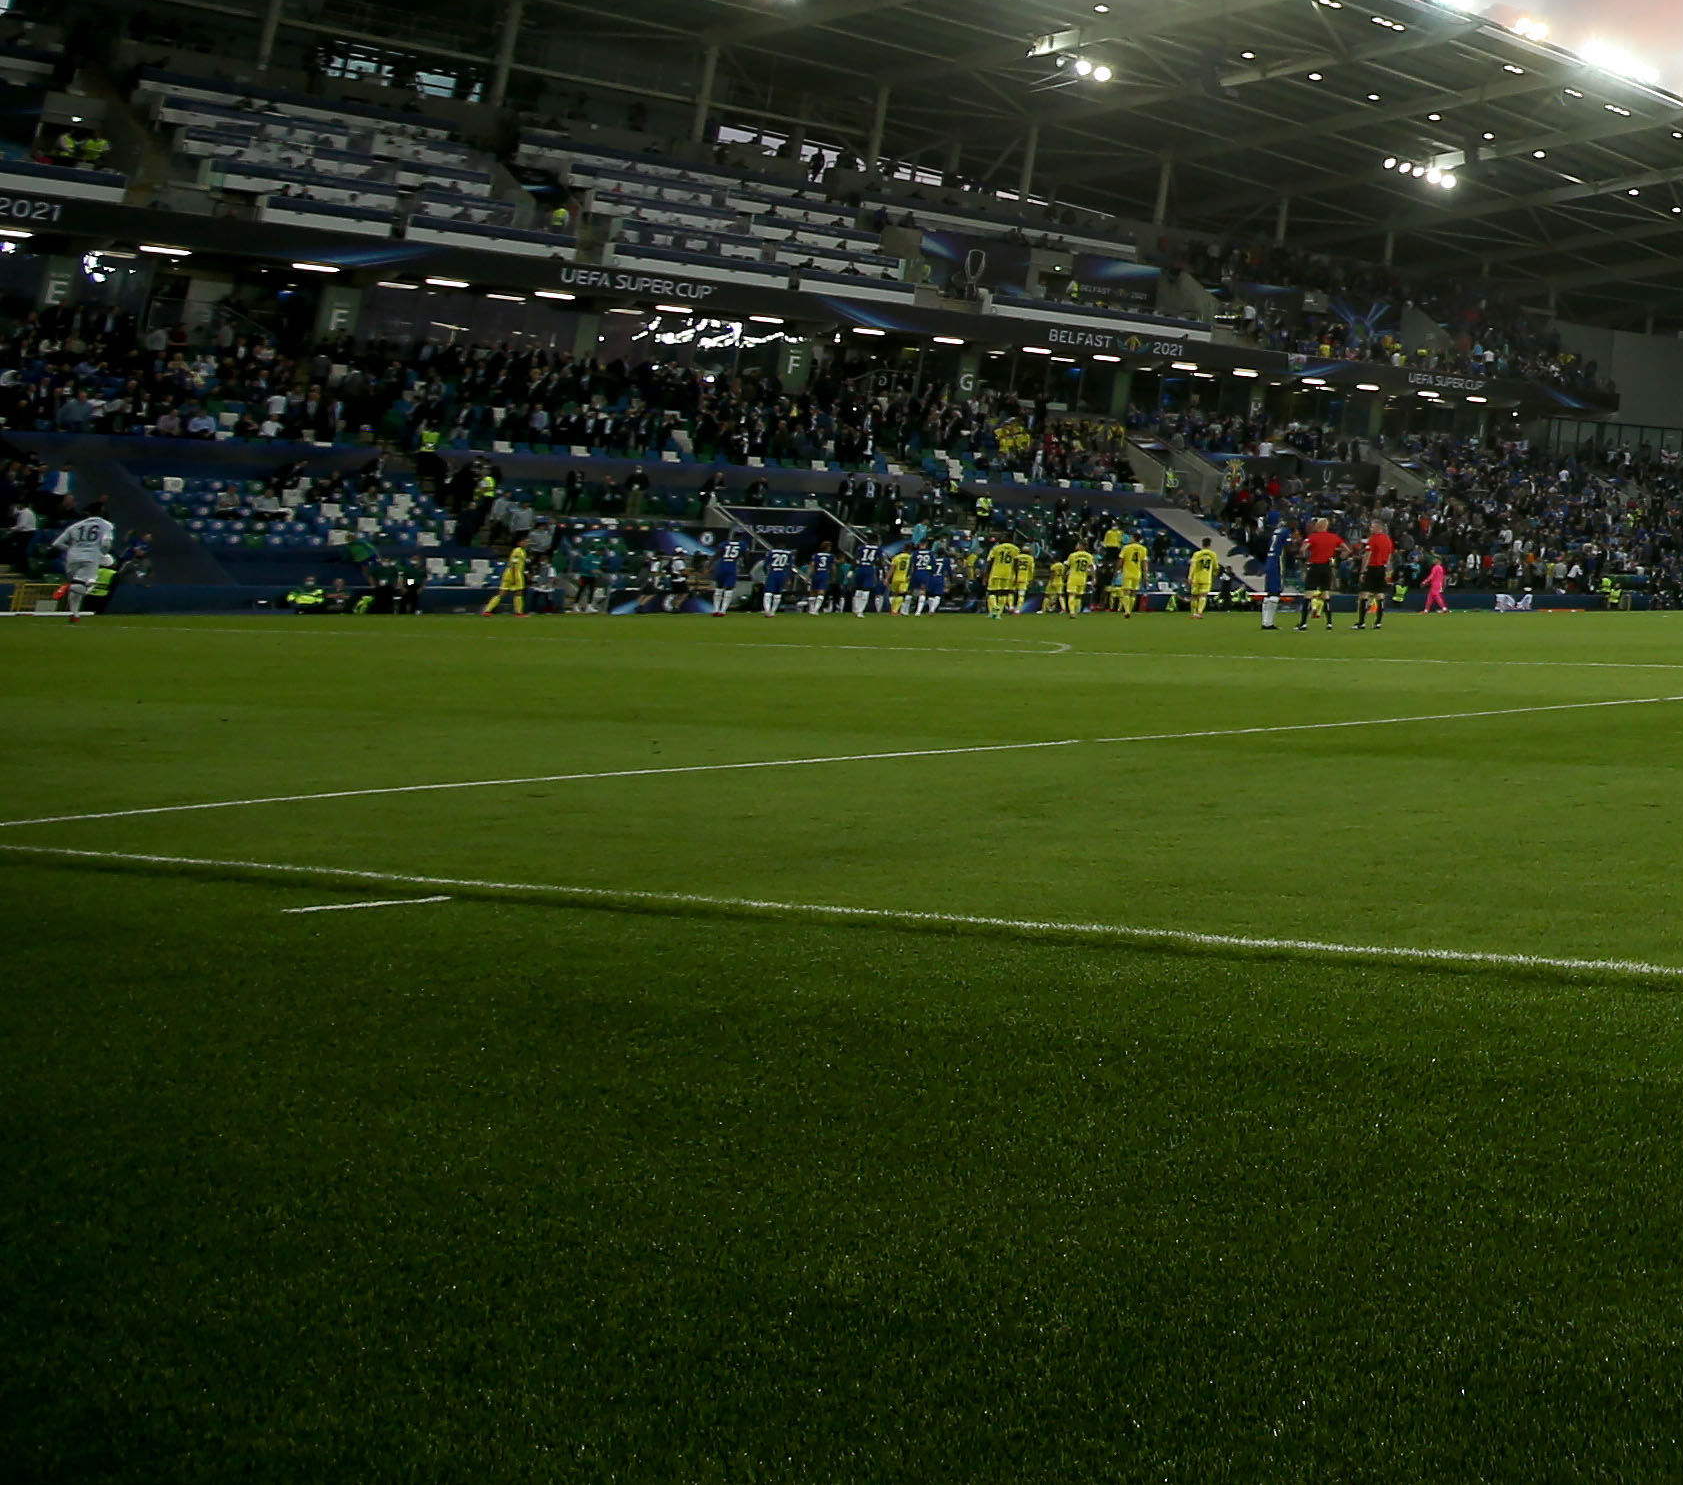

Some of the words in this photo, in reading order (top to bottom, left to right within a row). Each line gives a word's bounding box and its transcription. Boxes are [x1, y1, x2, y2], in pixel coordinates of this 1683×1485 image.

[0, 196, 62, 222] 2021
[560, 267, 611, 289] UEFA
[614, 274, 674, 296] SUPER
[675, 282, 713, 299] CUP
[1048, 328, 1113, 349] BELFAST
[1152, 341, 1184, 357] 2021
[959, 373, 975, 391] G
[77, 524, 100, 543] 16
[723, 545, 741, 559] 15
[771, 553, 788, 567] 20
[861, 549, 877, 562] 14
[1000, 550, 1013, 564] 16
[818, 556, 828, 568] 3
